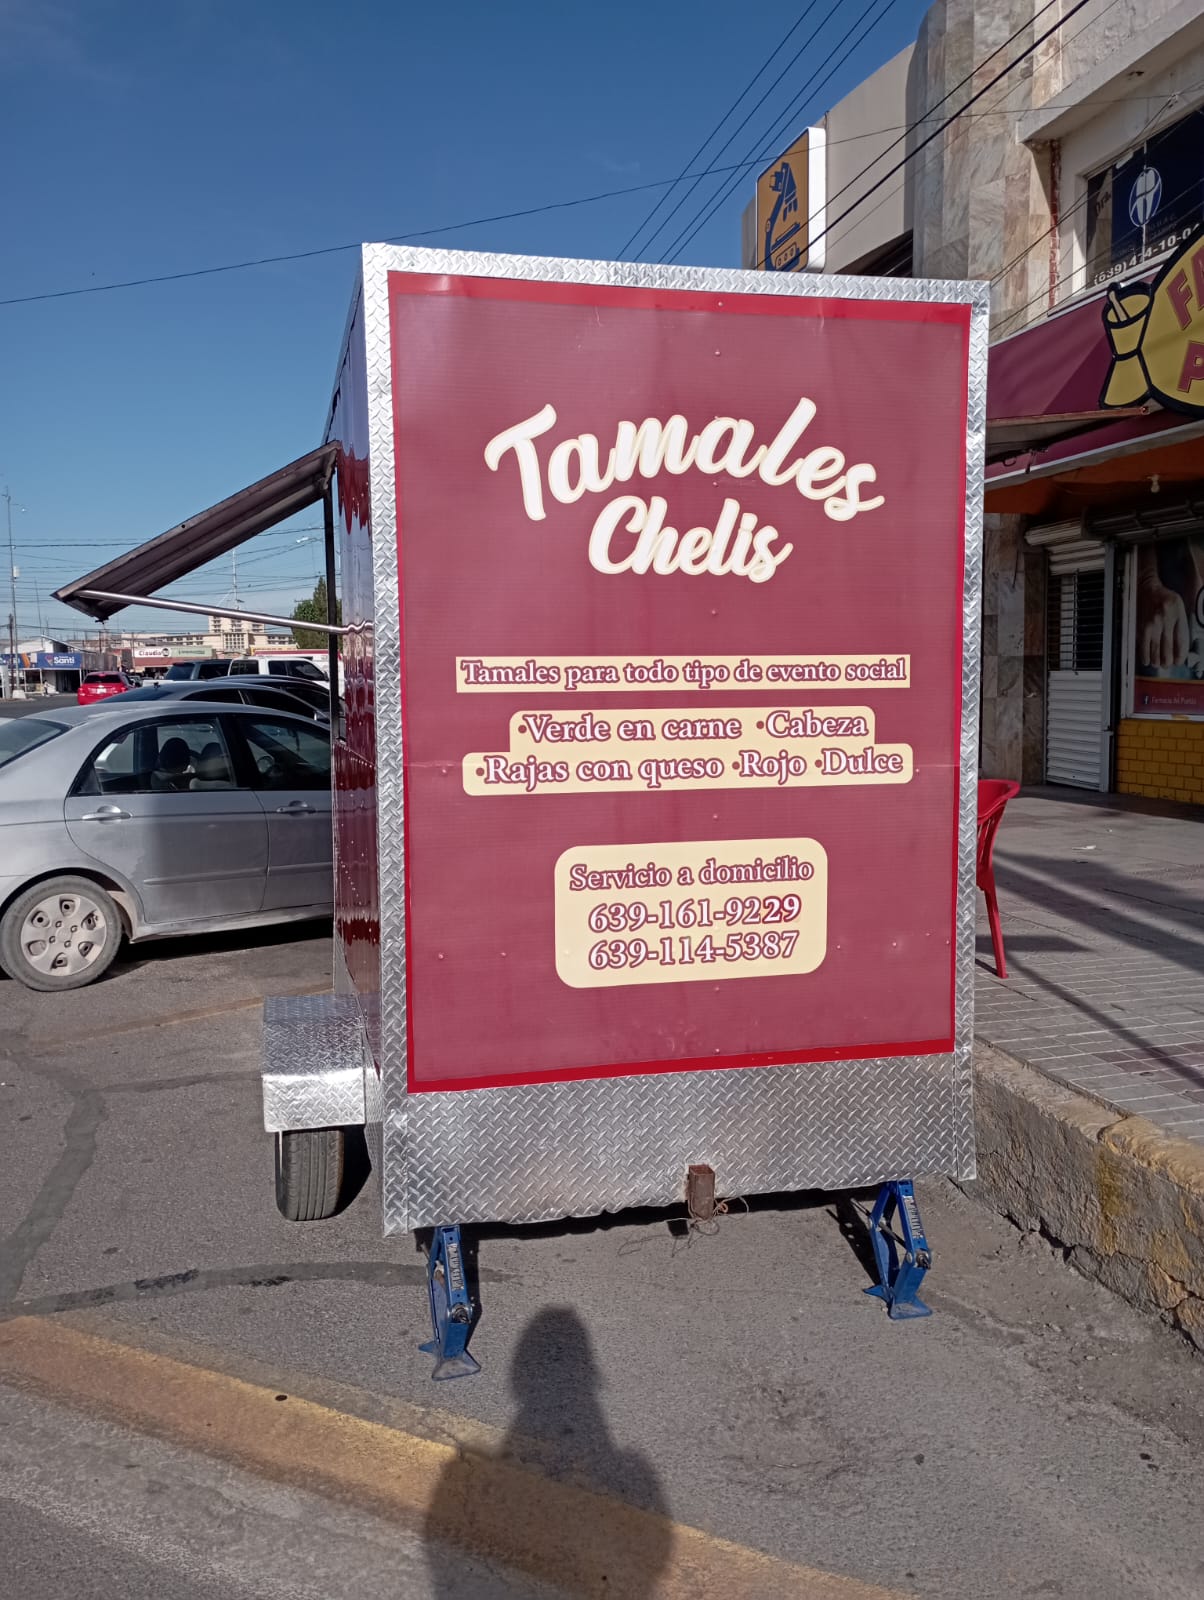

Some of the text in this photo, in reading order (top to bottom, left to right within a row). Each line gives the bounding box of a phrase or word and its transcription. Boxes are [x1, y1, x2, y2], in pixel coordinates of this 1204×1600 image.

[484, 397, 885, 521] Tamales
[588, 495, 793, 583] Chelis
[461, 658, 906, 690] Tamales para todo tipo de evento social
[617, 719, 655, 741] en
[662, 718, 742, 740] carne
[575, 760, 631, 782] con
[638, 757, 725, 788] queso
[570, 855, 815, 891] Servicio a domicilio
[588, 894, 801, 933] 639-161-9229
[588, 930, 800, 970] 639-114-5387
